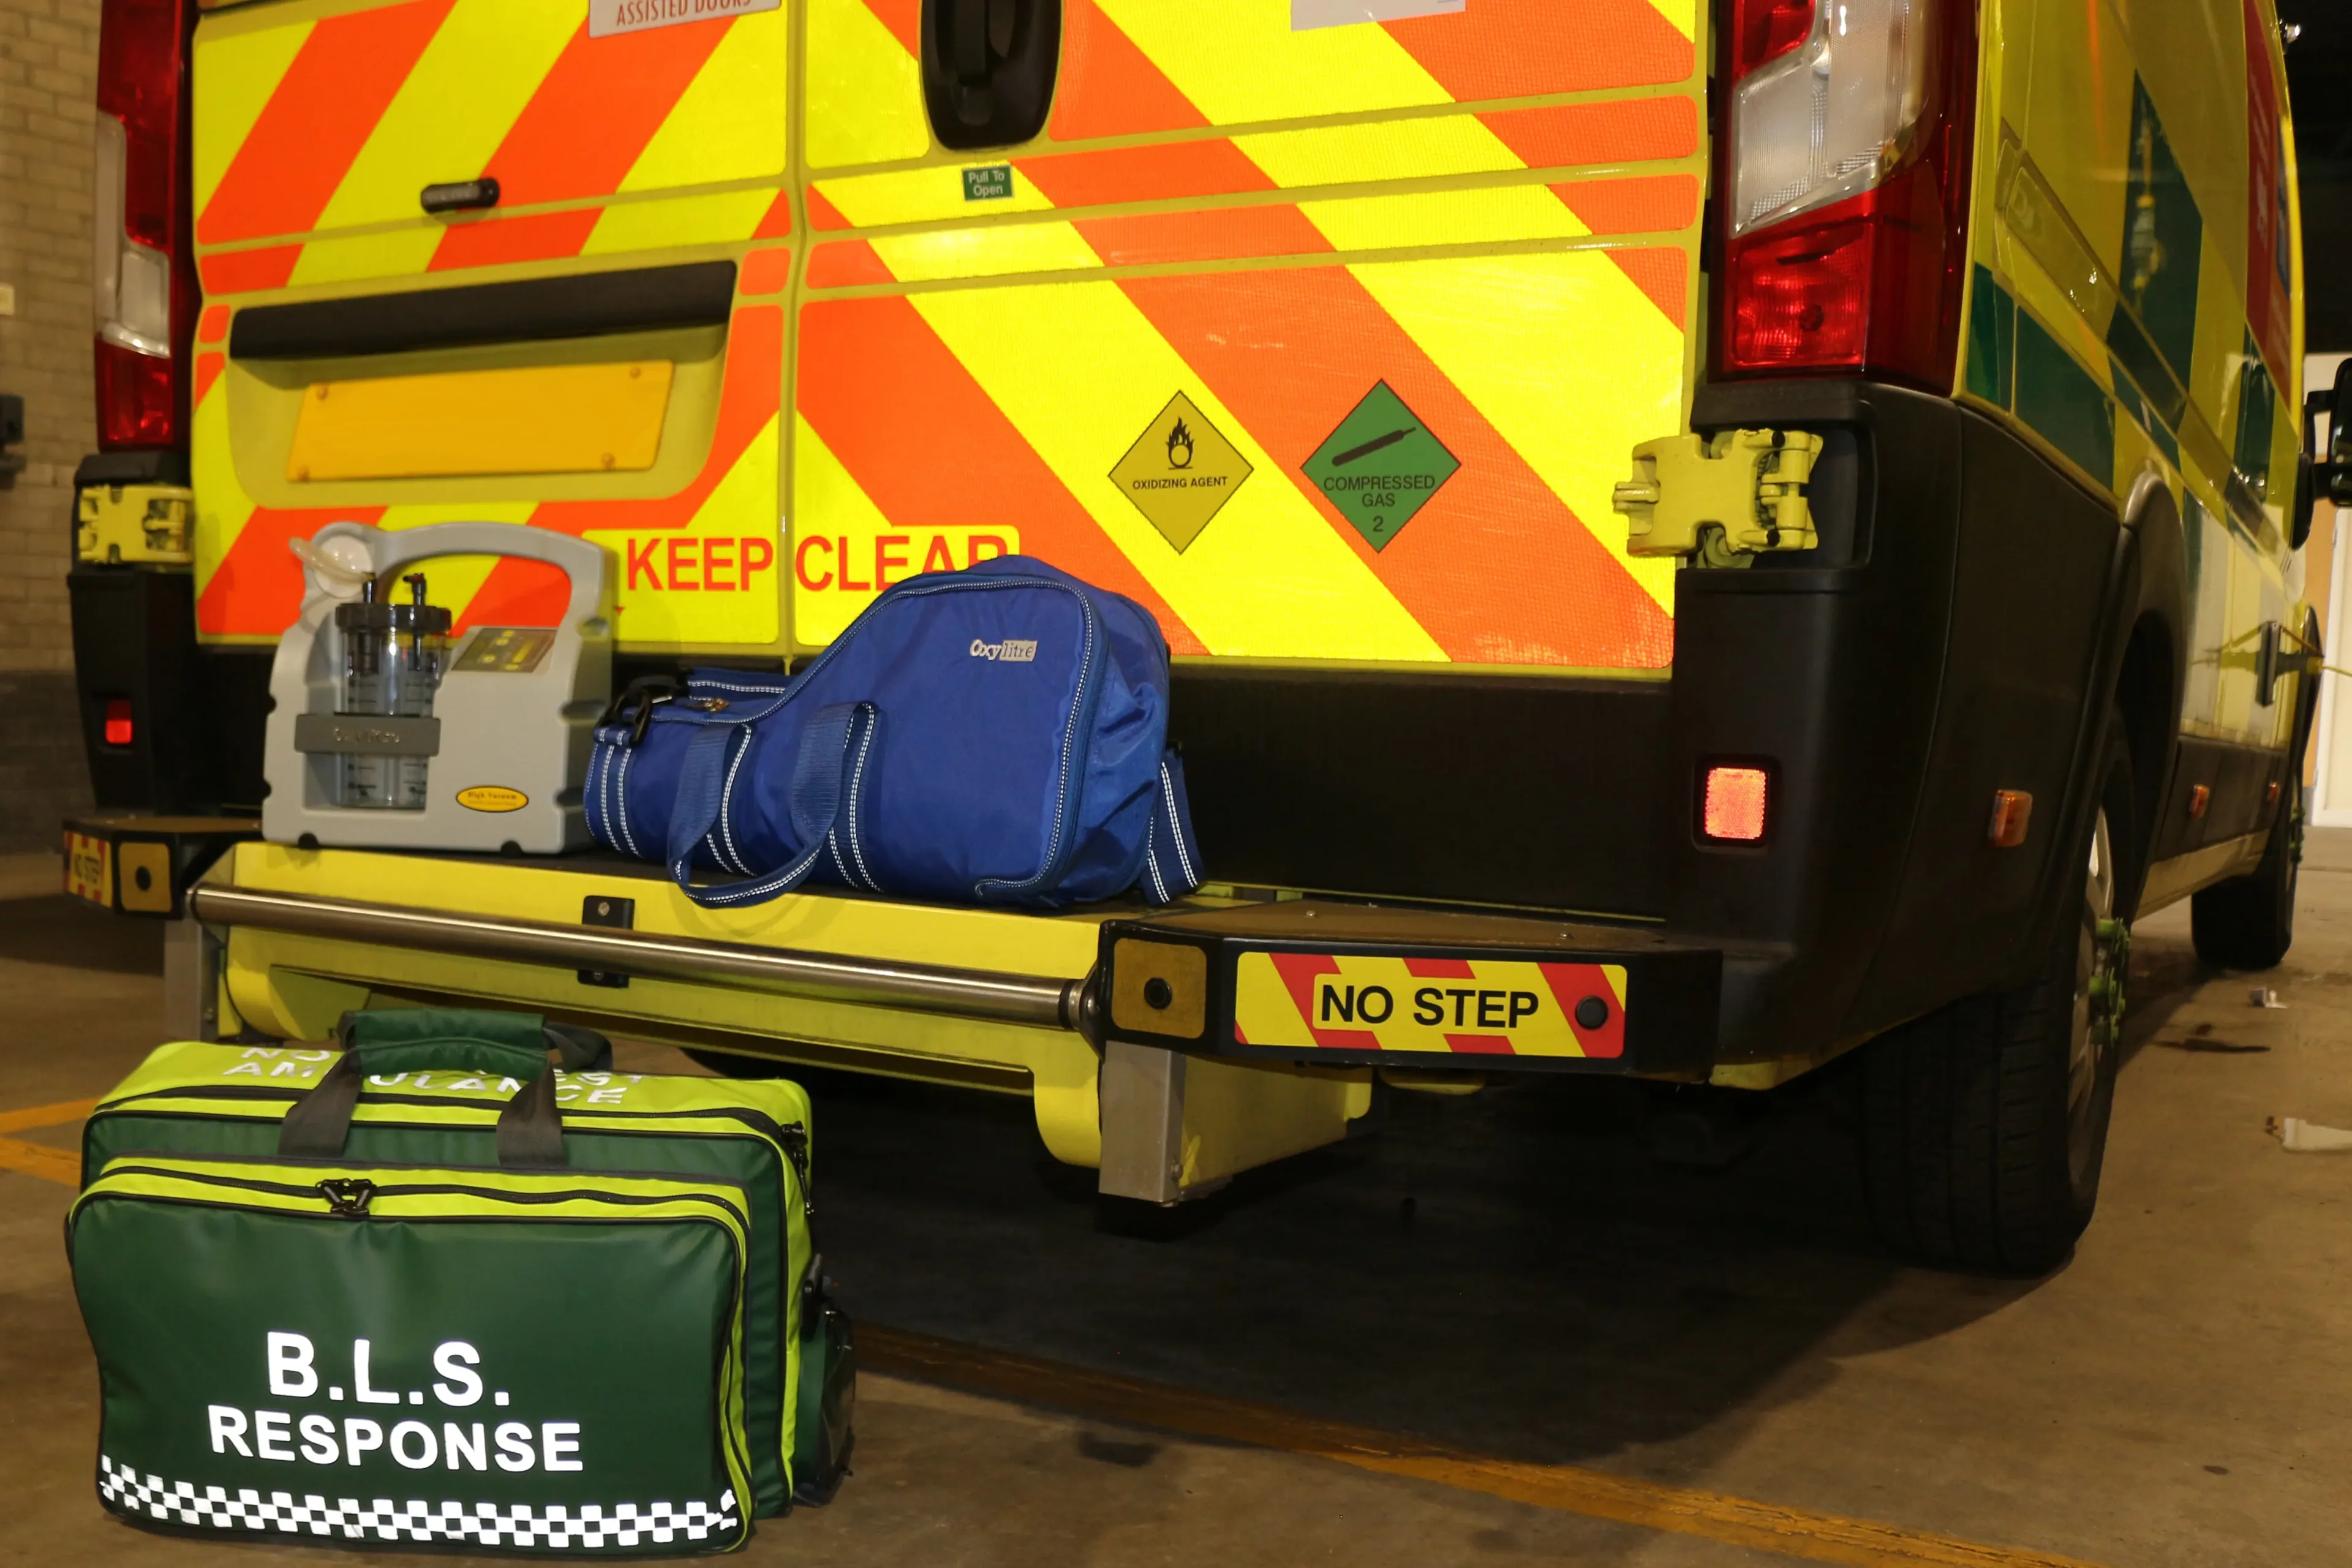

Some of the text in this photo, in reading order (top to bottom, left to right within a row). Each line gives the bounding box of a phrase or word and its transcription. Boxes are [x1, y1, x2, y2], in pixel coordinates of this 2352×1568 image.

[616, 0, 689, 26] ASSISTED
[968, 170, 1005, 184] Pull To
[973, 185, 1003, 198] Open
[1132, 475, 1228, 490] OXIDIZING AGENT
[1324, 475, 1436, 491] COMPRESSED
[1361, 492, 1396, 508] GAS
[1373, 516, 1384, 532] 2
[627, 537, 774, 592] KEEP
[970, 638, 1038, 662] Oxylitre
[1320, 984, 1539, 1028] NO STEP
[221, 1061, 628, 1104] AMULANCE
[267, 1331, 510, 1407] B.L.S.
[208, 1404, 584, 1472] RESPONSE
